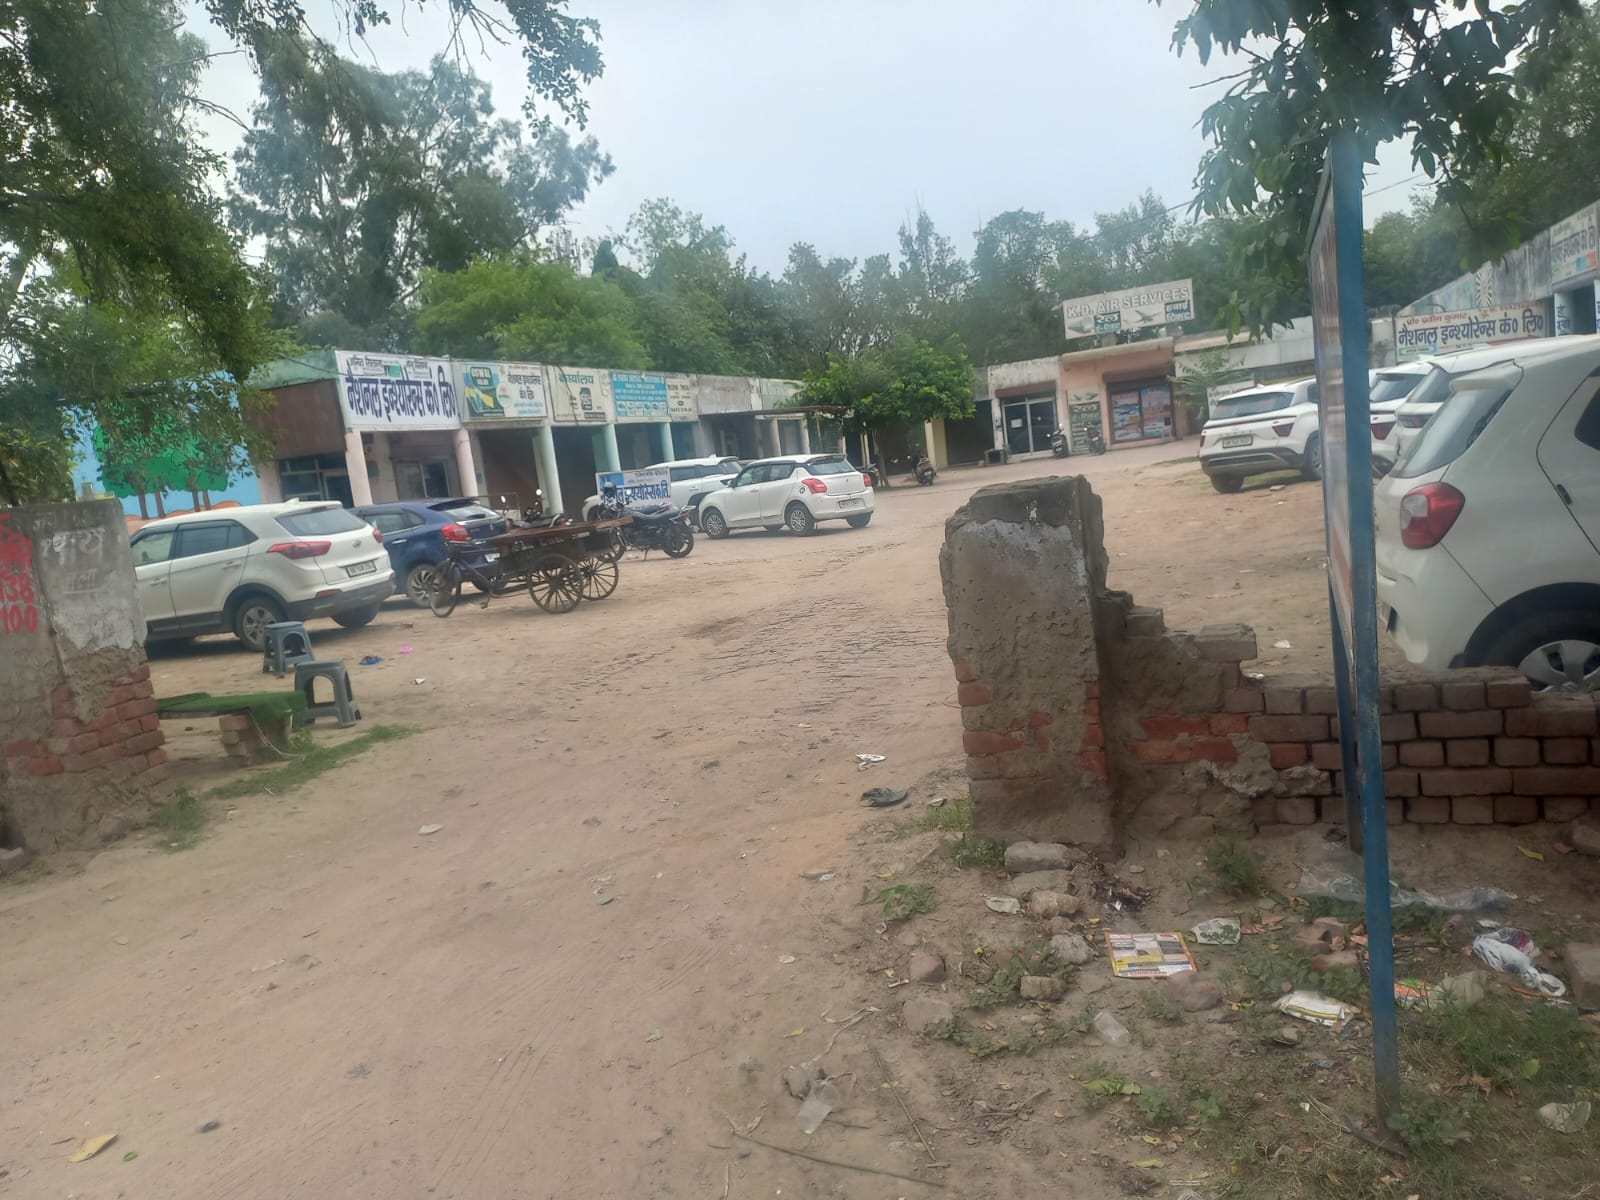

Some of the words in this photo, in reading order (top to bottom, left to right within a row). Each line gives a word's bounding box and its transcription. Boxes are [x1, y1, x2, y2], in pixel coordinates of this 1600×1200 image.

[1096, 299, 1120, 313] AIR
[1122, 287, 1190, 309] SERVICES
[1398, 323, 1438, 346] नैशनल
